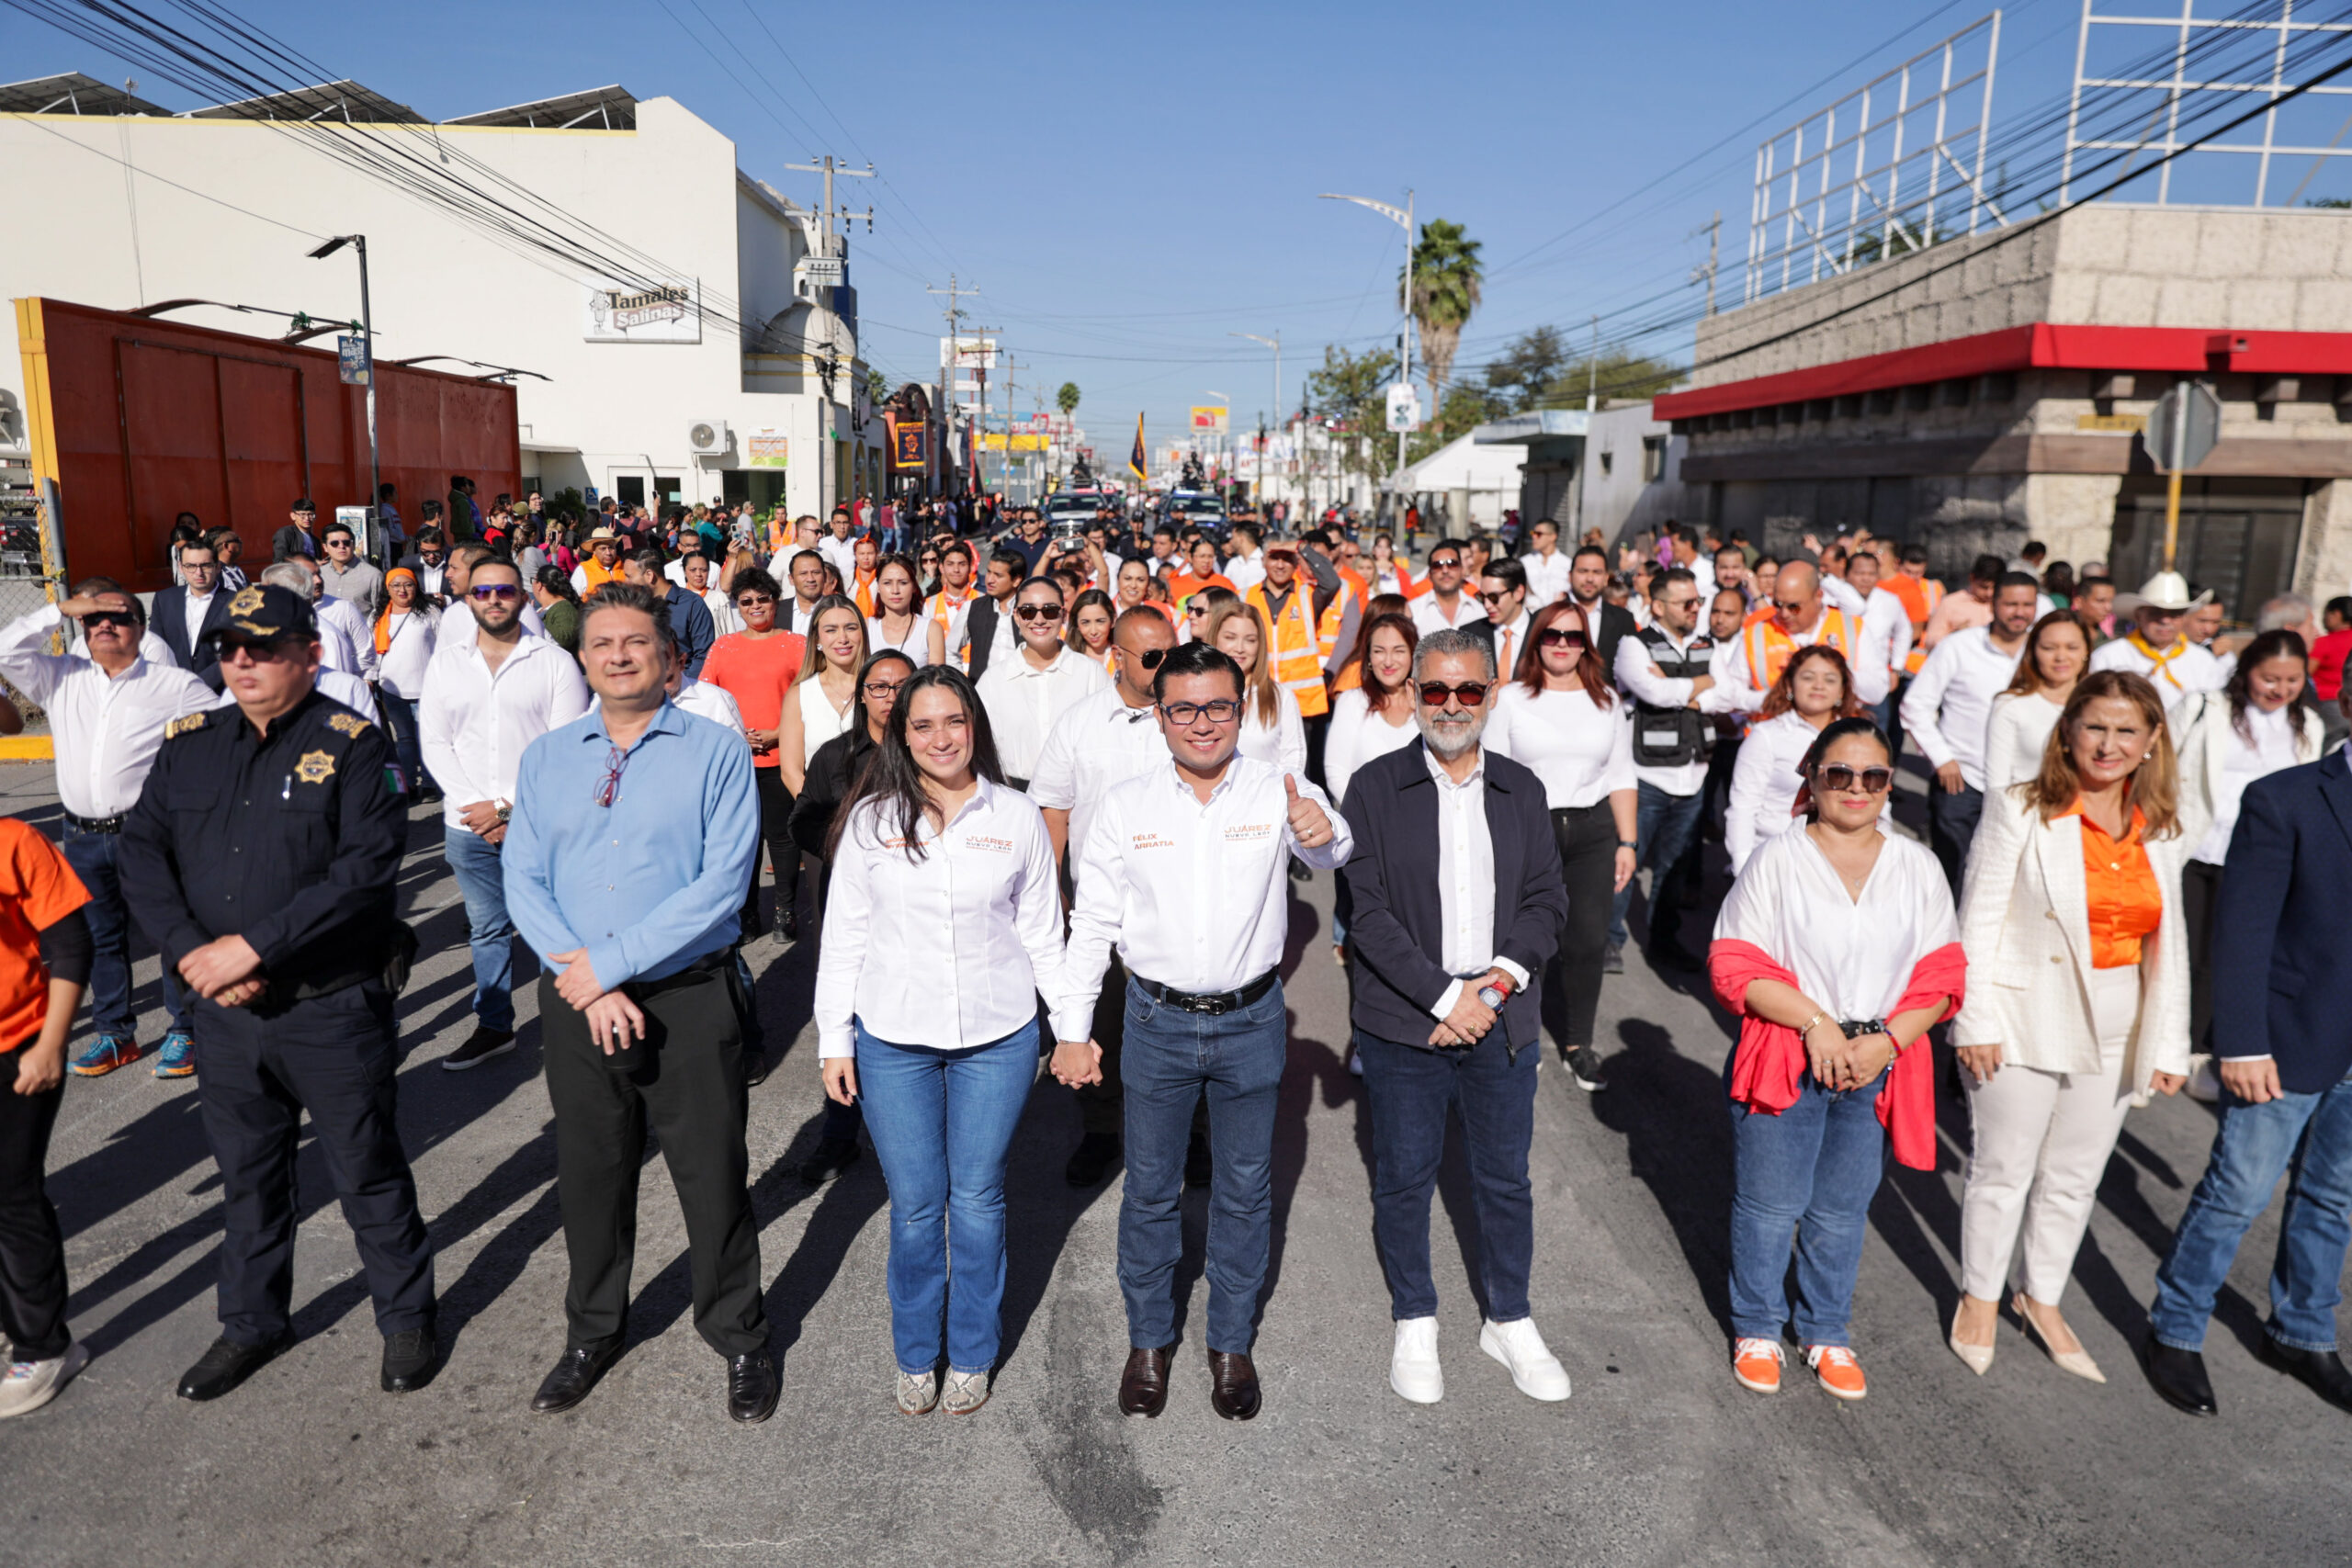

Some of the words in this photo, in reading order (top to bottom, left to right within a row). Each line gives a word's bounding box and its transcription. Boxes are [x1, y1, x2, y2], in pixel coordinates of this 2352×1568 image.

[606, 284, 689, 309] Tamales
[616, 306, 681, 327] Salinas
[1225, 824, 1272, 833] JUÁREZ
[966, 836, 1012, 846] JUÁREZ
[1133, 833, 1158, 841] FÉLIX
[1135, 840, 1174, 850] ARRATIA
